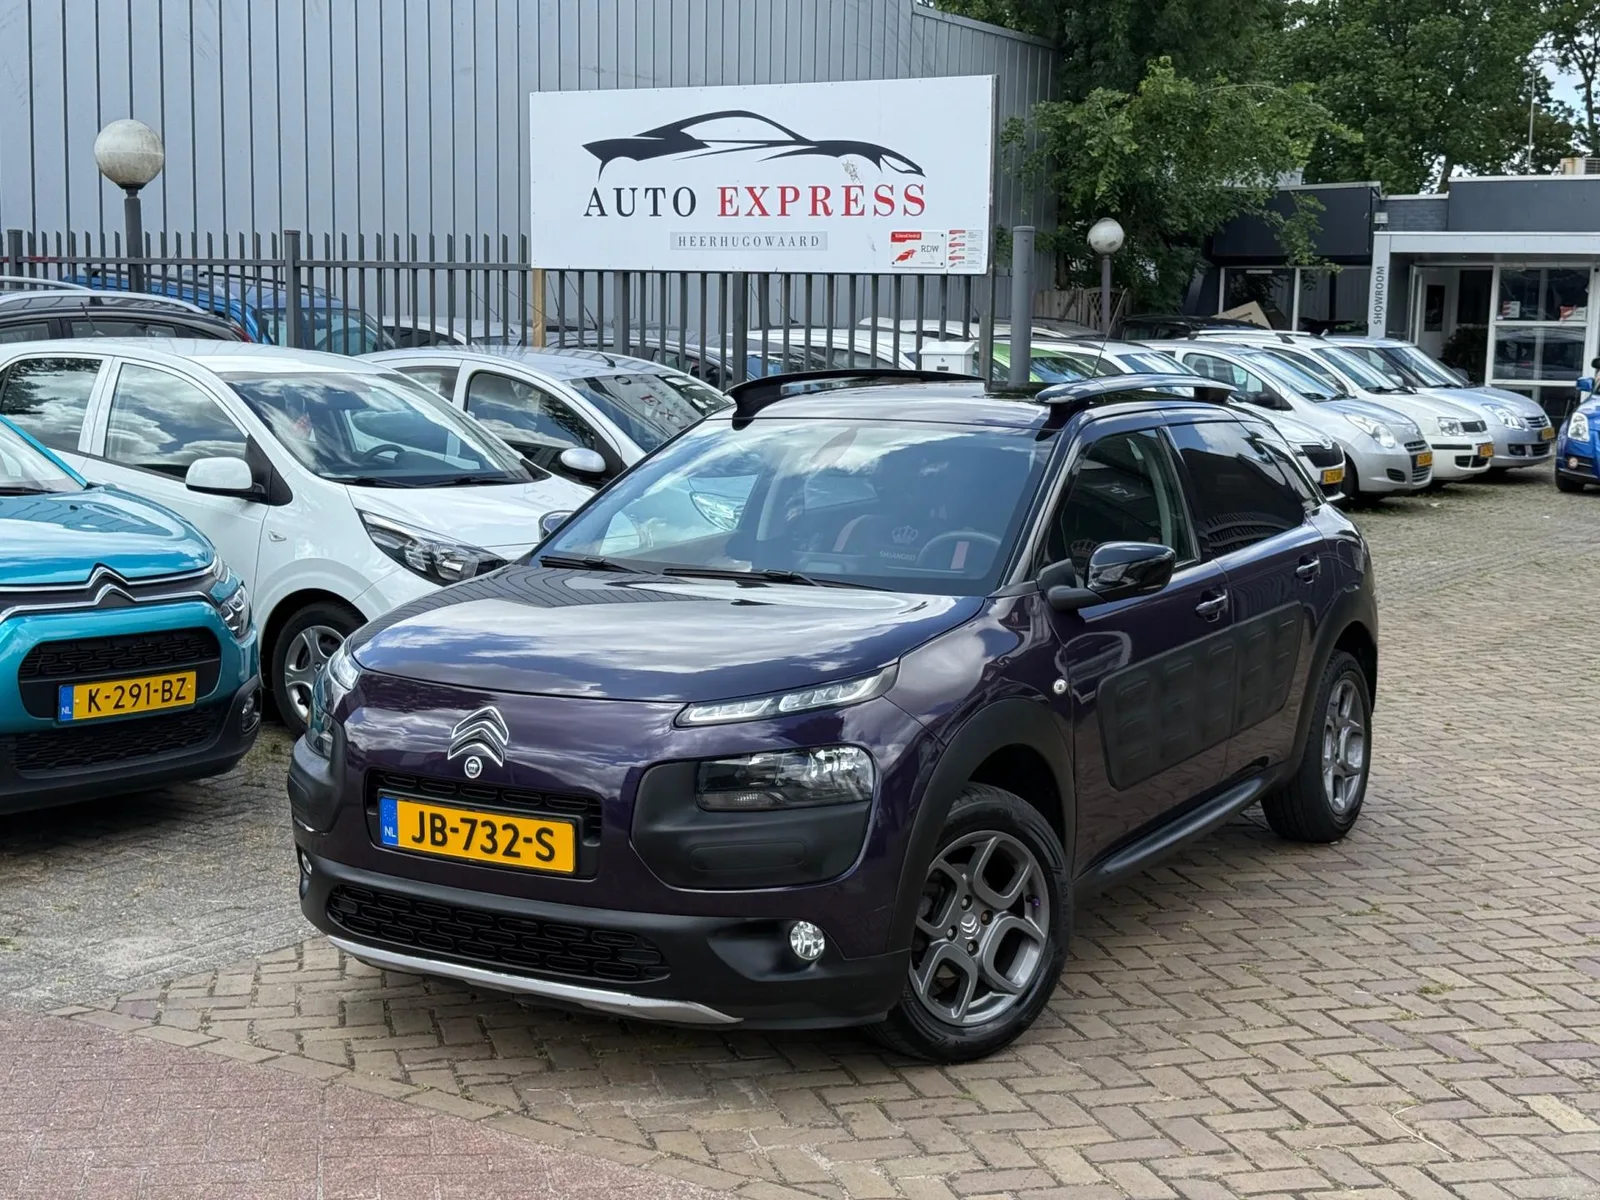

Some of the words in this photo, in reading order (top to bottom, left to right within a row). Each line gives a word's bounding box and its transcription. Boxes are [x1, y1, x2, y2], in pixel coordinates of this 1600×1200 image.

[583, 186, 697, 218] AUTO
[716, 183, 926, 217] EXPRESS
[678, 235, 820, 247] HEERHUGOWAARD
[920, 244, 940, 253] RDW
[1373, 266, 1385, 325] SHOWROOM
[61, 706, 72, 715] NL
[87, 677, 188, 713] K-291-BZ
[384, 825, 397, 838] NL
[411, 810, 556, 862] JB-732-S
